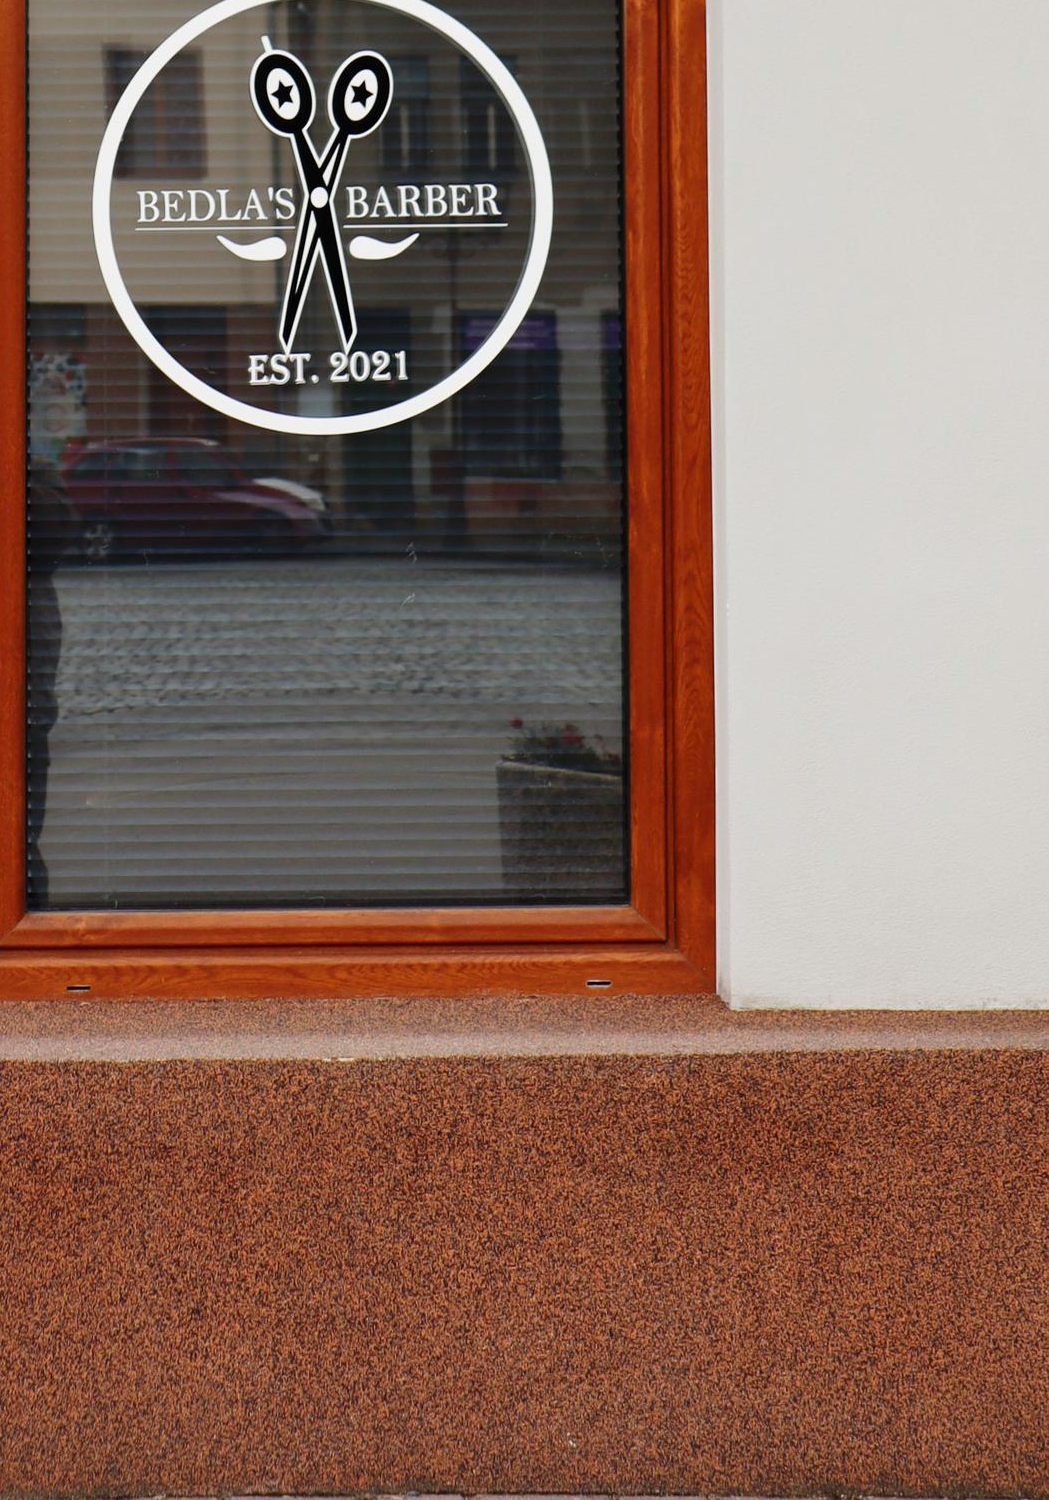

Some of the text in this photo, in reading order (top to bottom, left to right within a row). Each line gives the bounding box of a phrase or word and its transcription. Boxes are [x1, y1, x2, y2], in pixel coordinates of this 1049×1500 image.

[135, 183, 502, 224] BEDLA'S BARBER
[248, 350, 409, 386] EST. 2021
